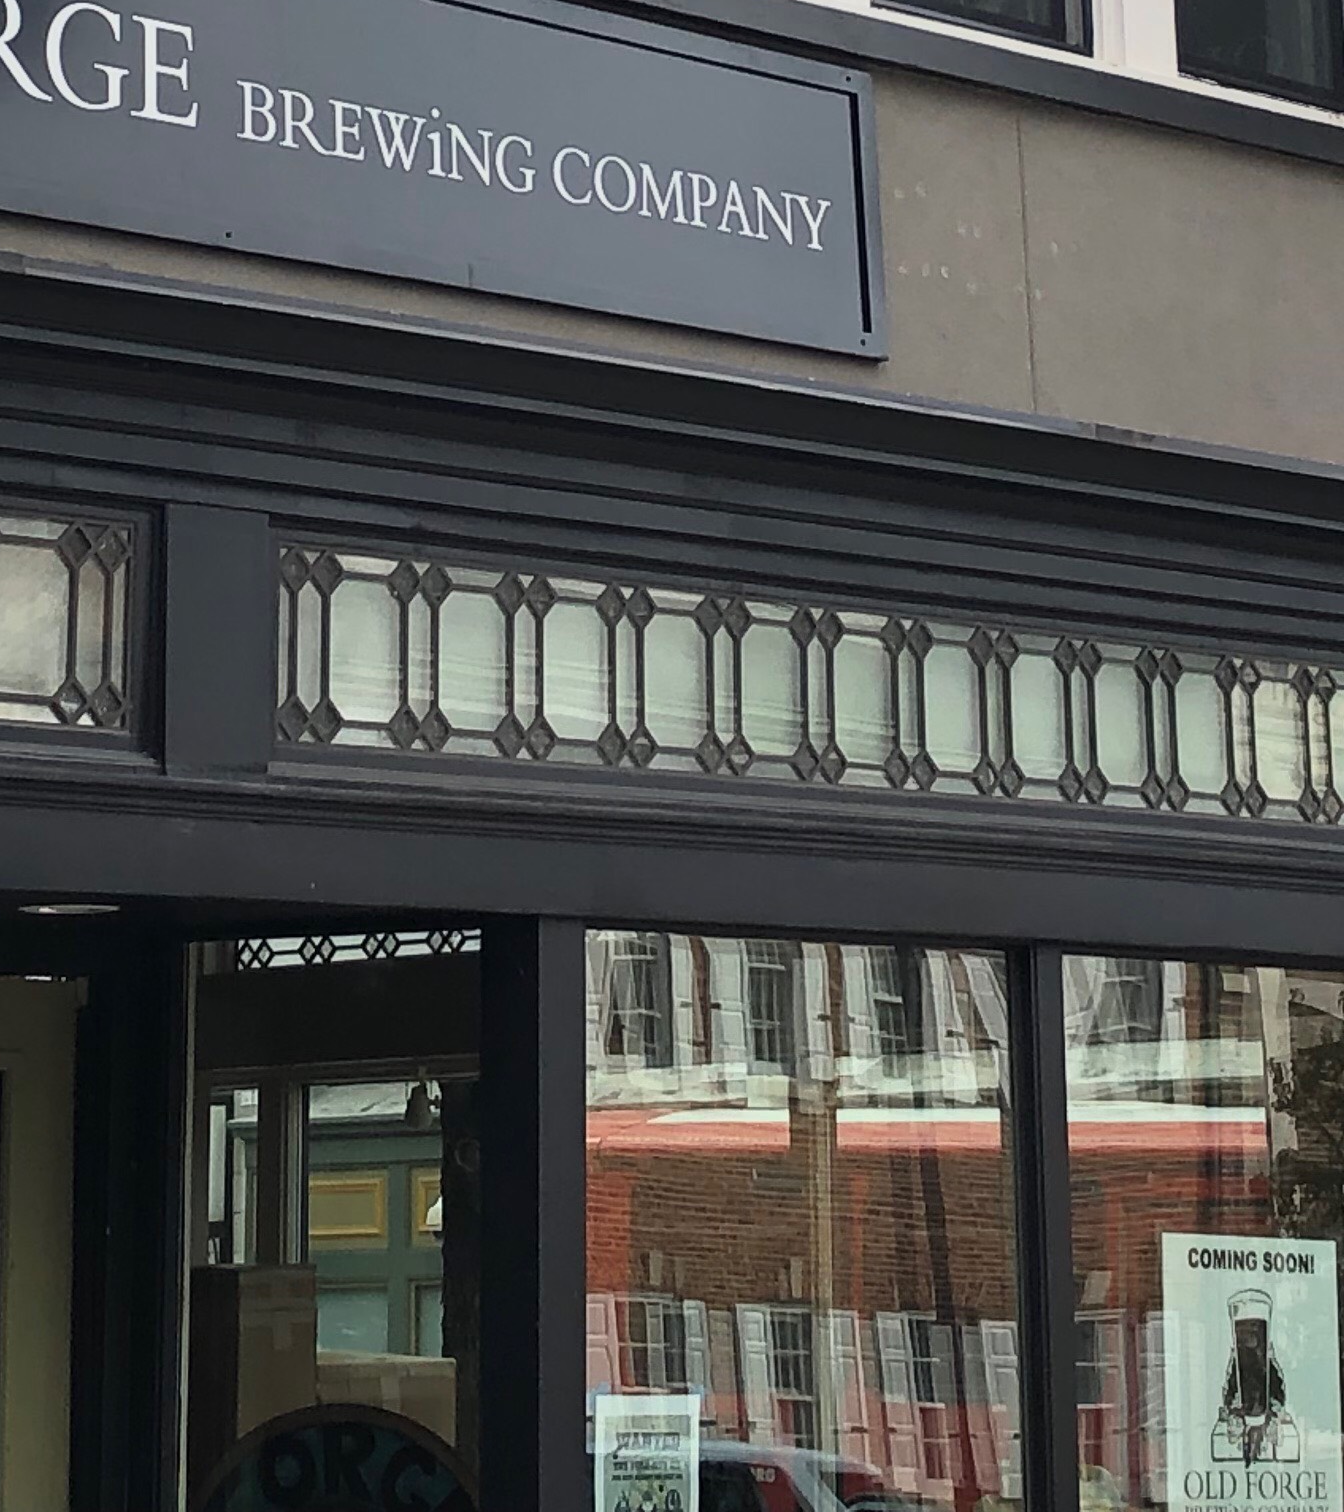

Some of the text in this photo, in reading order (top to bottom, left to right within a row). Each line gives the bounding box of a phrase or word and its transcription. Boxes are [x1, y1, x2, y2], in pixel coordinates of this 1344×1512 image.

[552, 146, 832, 252] COMPANY
[1187, 1247, 1316, 1275] COMING SOON!
[1184, 1469, 1329, 1501] OLD FORGE
